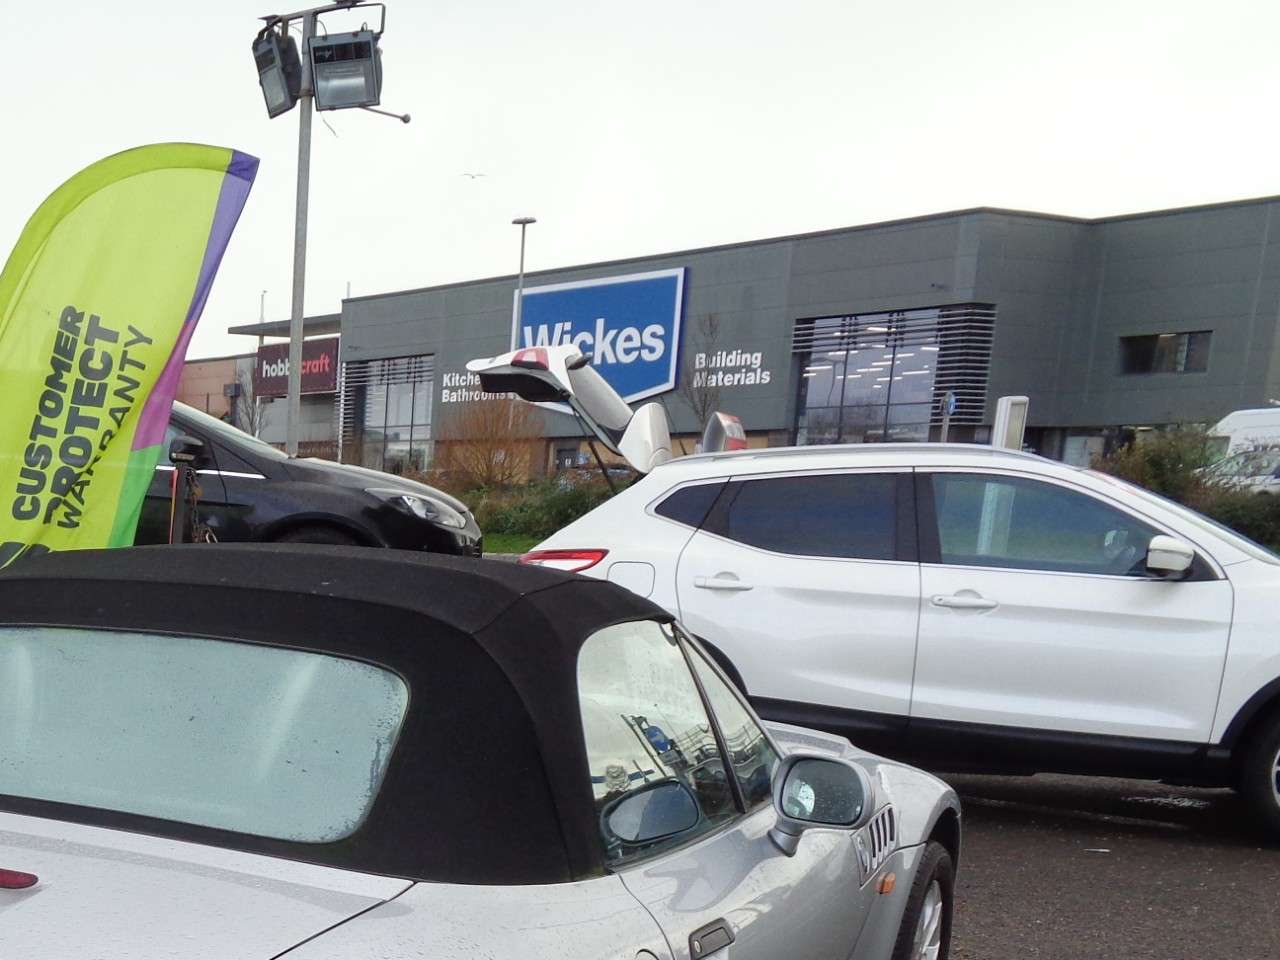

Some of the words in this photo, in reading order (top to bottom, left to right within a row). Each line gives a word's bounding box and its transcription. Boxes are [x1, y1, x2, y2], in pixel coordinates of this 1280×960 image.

[695, 349, 762, 368] Building
[442, 371, 481, 387] Kitche
[693, 368, 771, 388] Materials
[12, 305, 85, 521] CUSTOMER
[43, 314, 119, 525] PROTECT
